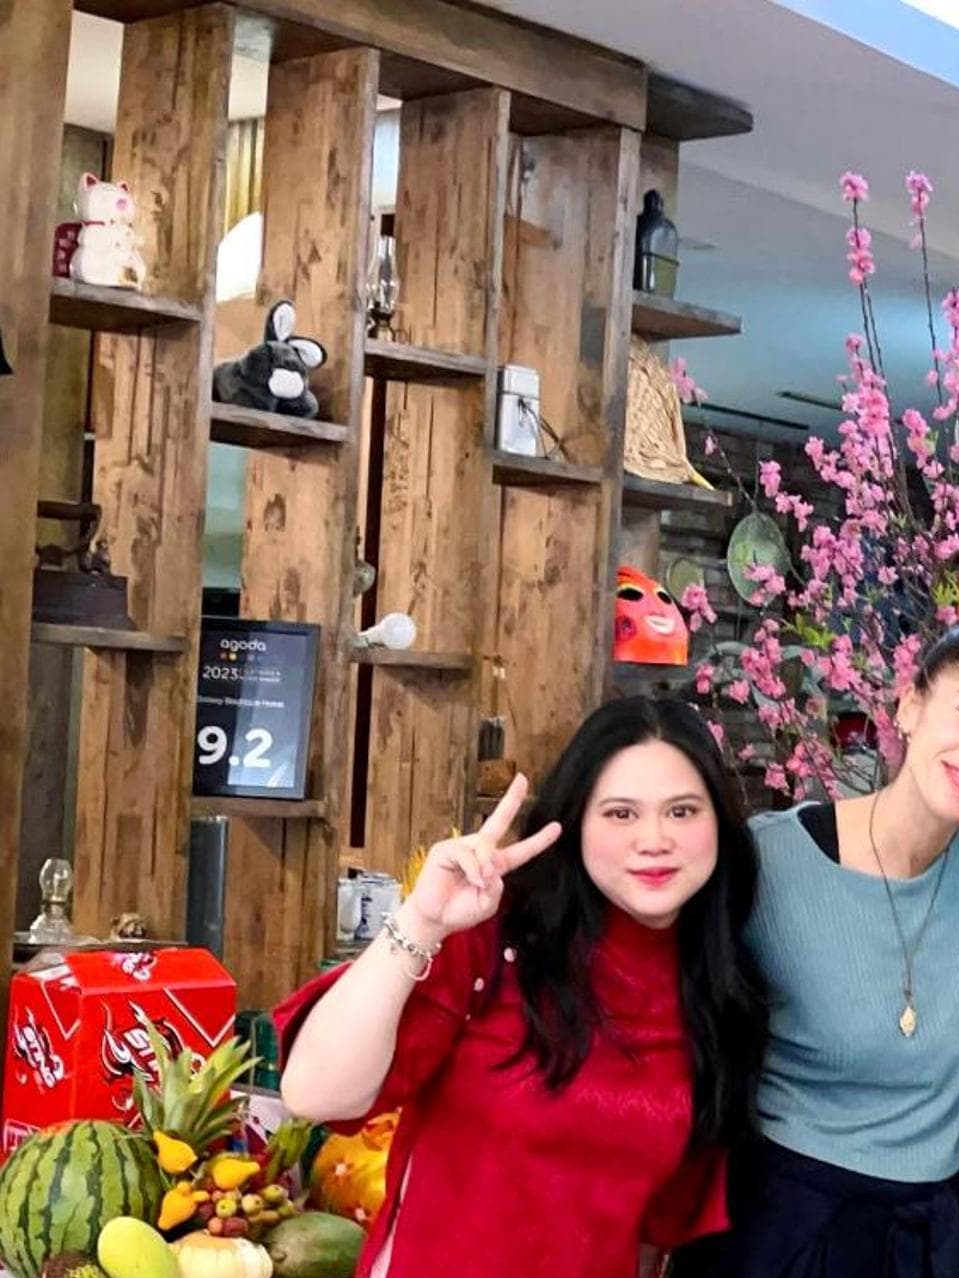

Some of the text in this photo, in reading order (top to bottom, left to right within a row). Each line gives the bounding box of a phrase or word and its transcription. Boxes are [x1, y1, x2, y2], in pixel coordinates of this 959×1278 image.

[220, 638, 267, 652] agoda
[202, 665, 239, 680] 2023
[197, 725, 273, 768] 9.2
